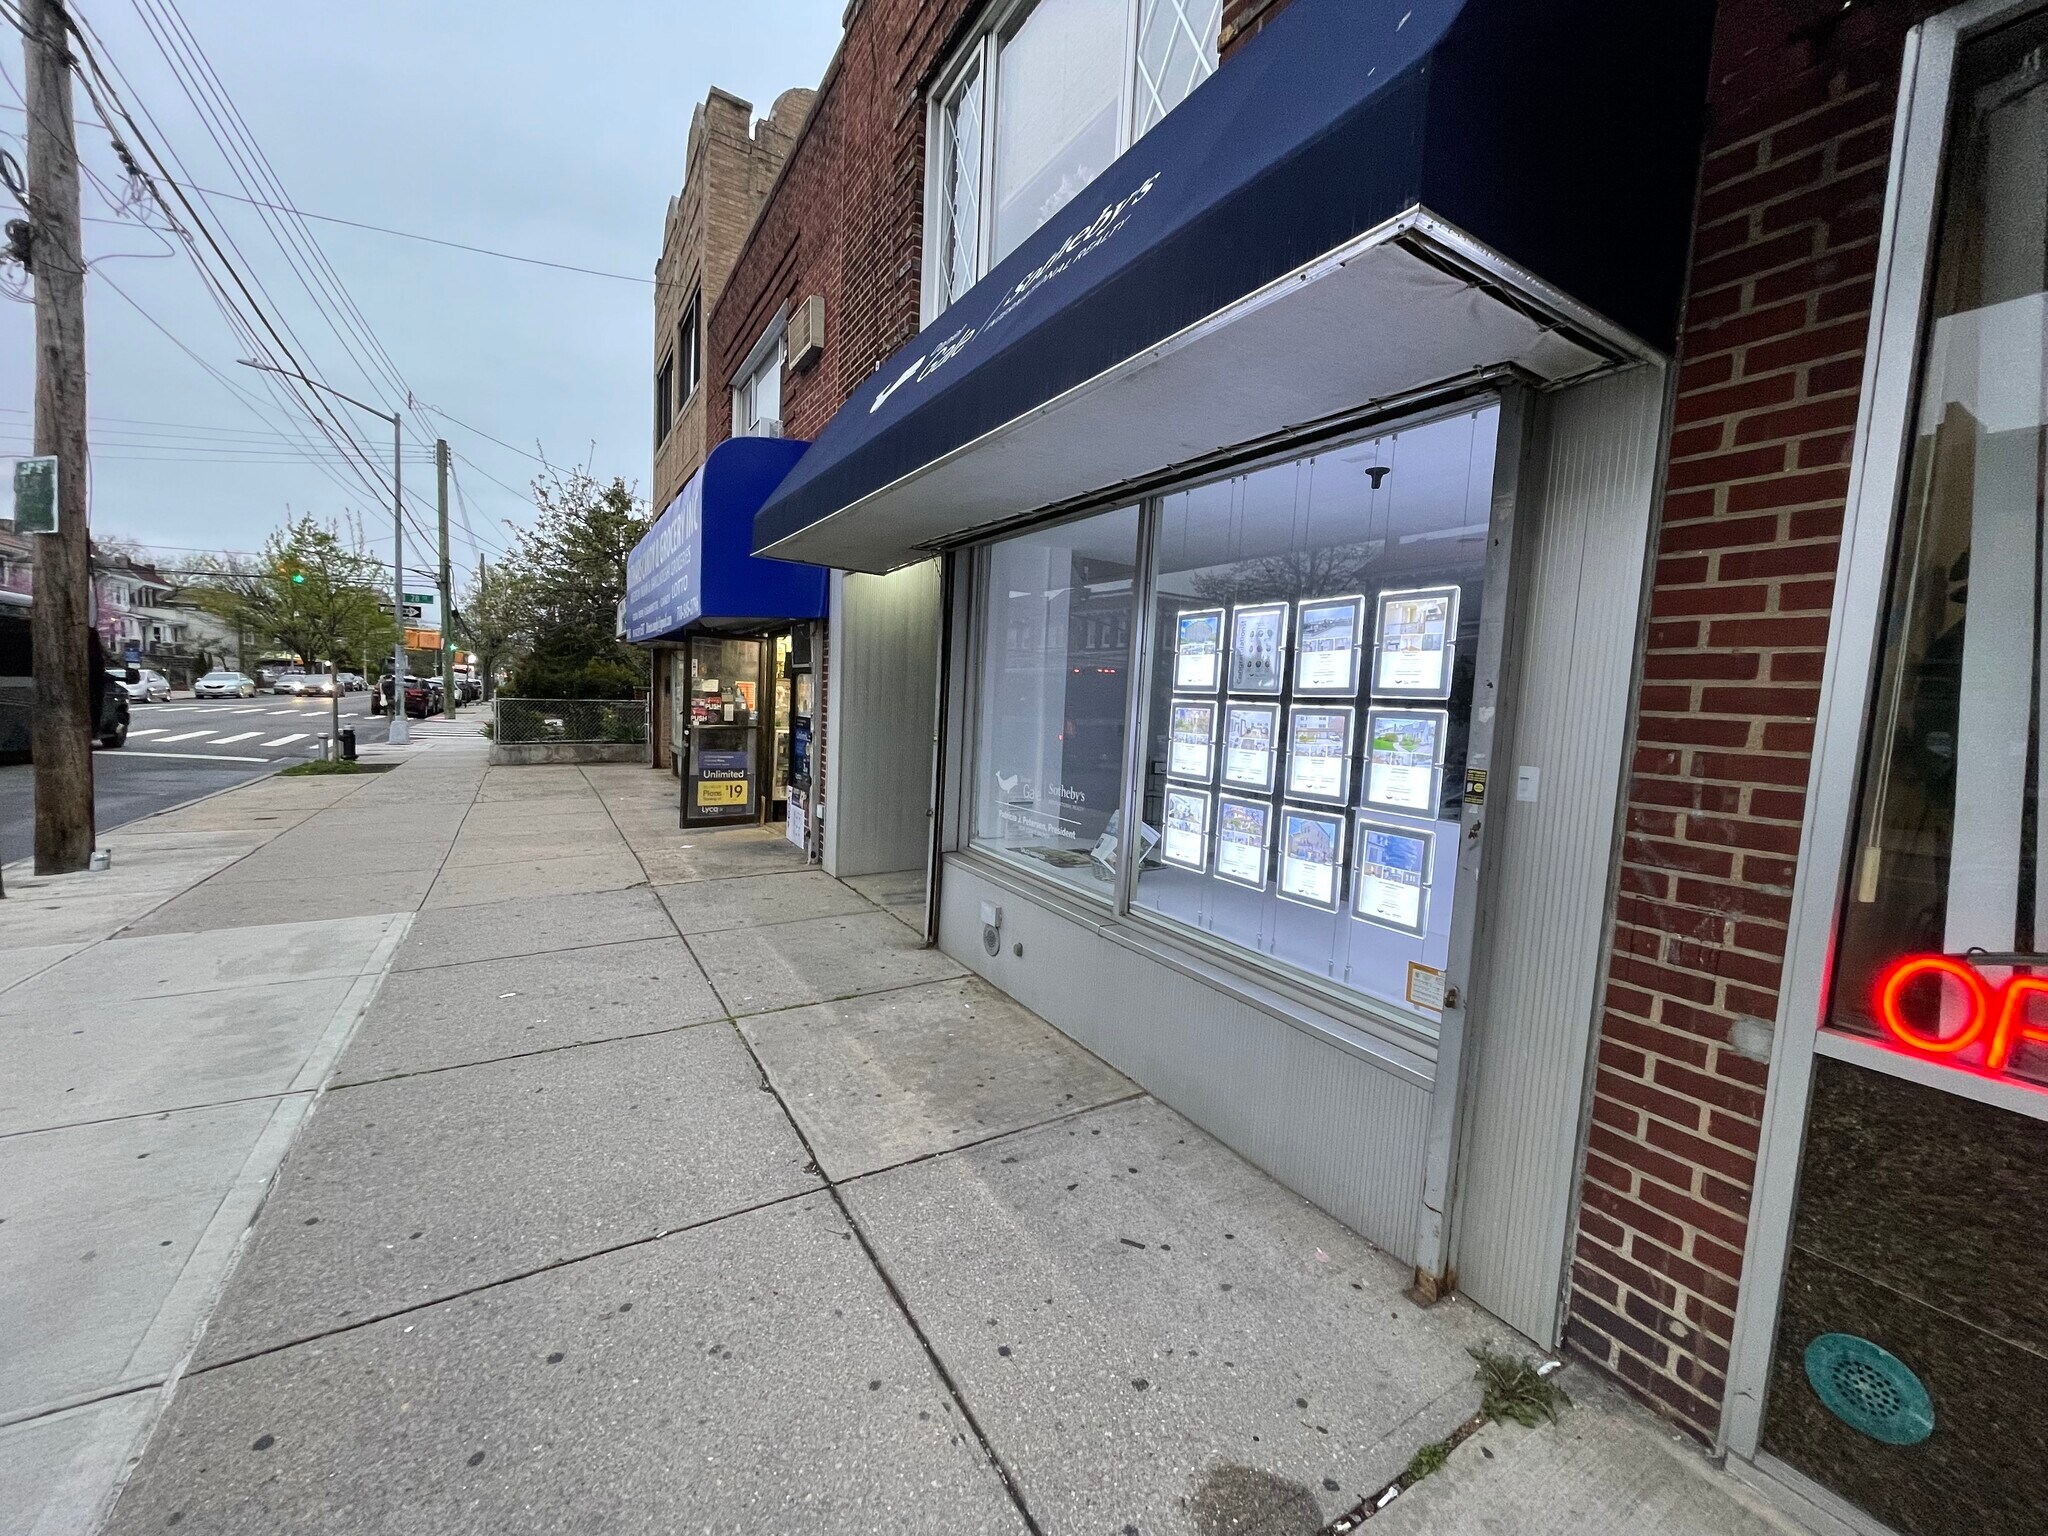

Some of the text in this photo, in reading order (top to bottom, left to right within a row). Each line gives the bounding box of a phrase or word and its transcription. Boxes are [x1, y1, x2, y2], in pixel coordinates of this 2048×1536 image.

[703, 769, 744, 779] Unlimited
[702, 789, 722, 797] Plans
[1048, 783, 1086, 804] Sotheby's
[701, 805, 719, 814] Lyca
[1047, 823, 1077, 840] President
